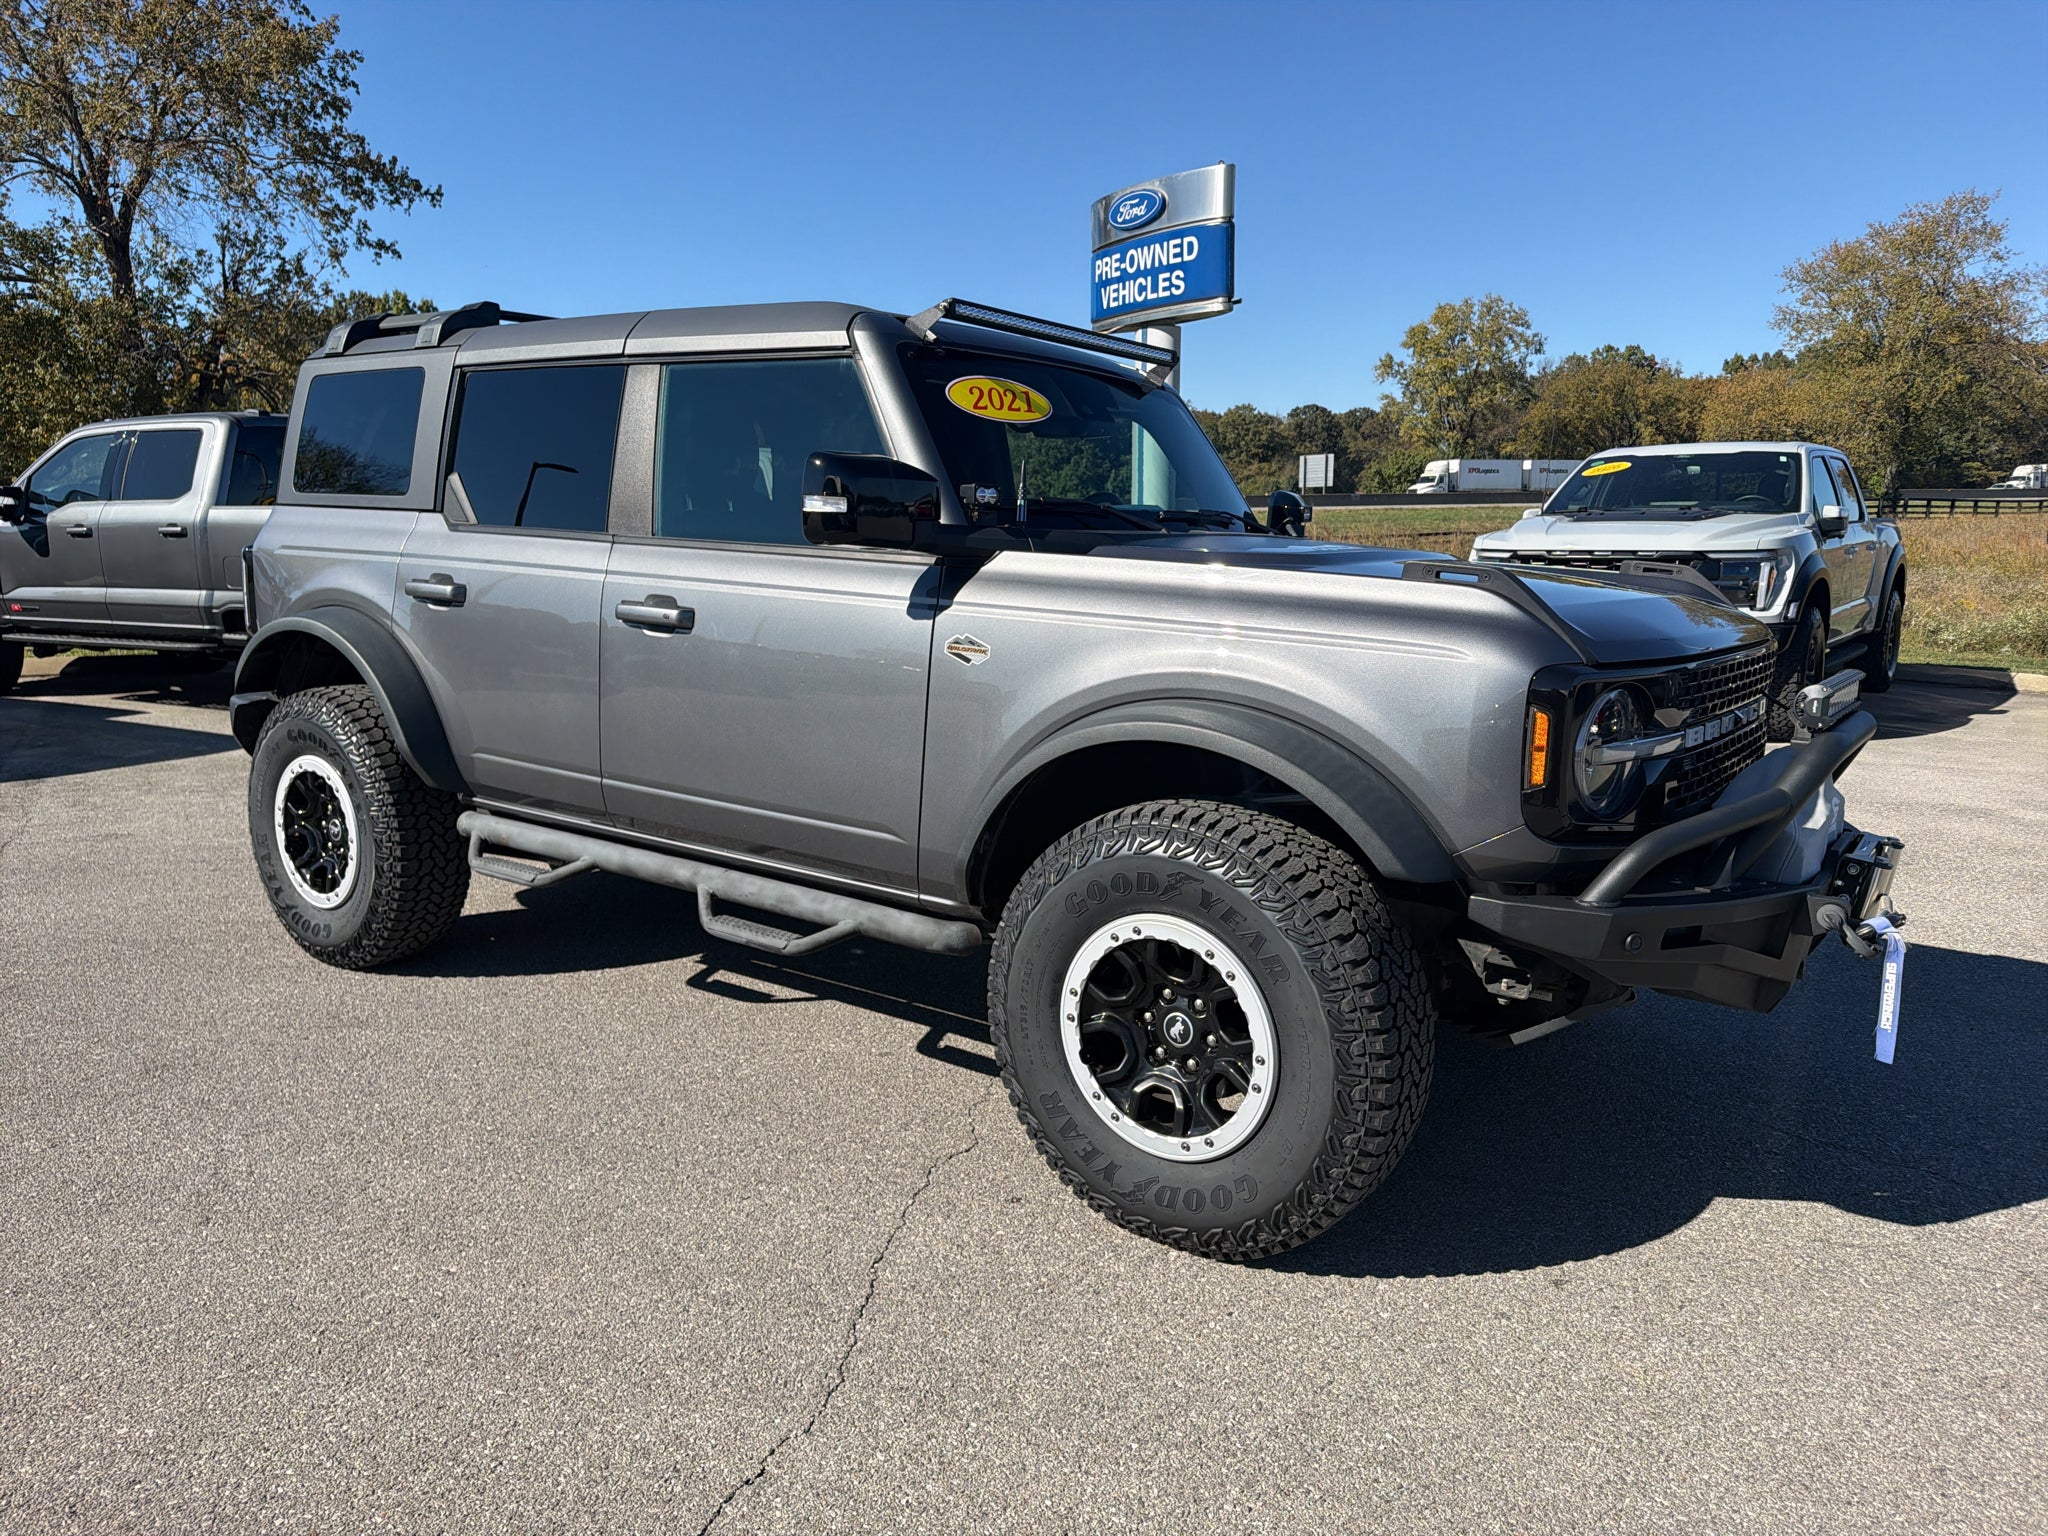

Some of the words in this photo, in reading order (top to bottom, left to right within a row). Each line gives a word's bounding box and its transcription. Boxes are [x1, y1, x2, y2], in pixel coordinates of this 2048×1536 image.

[1117, 198, 1148, 223] Ford
[1095, 236, 1199, 283] PRE-OWNED
[1101, 270, 1186, 310] VEHICLES
[968, 386, 1037, 413] 2021
